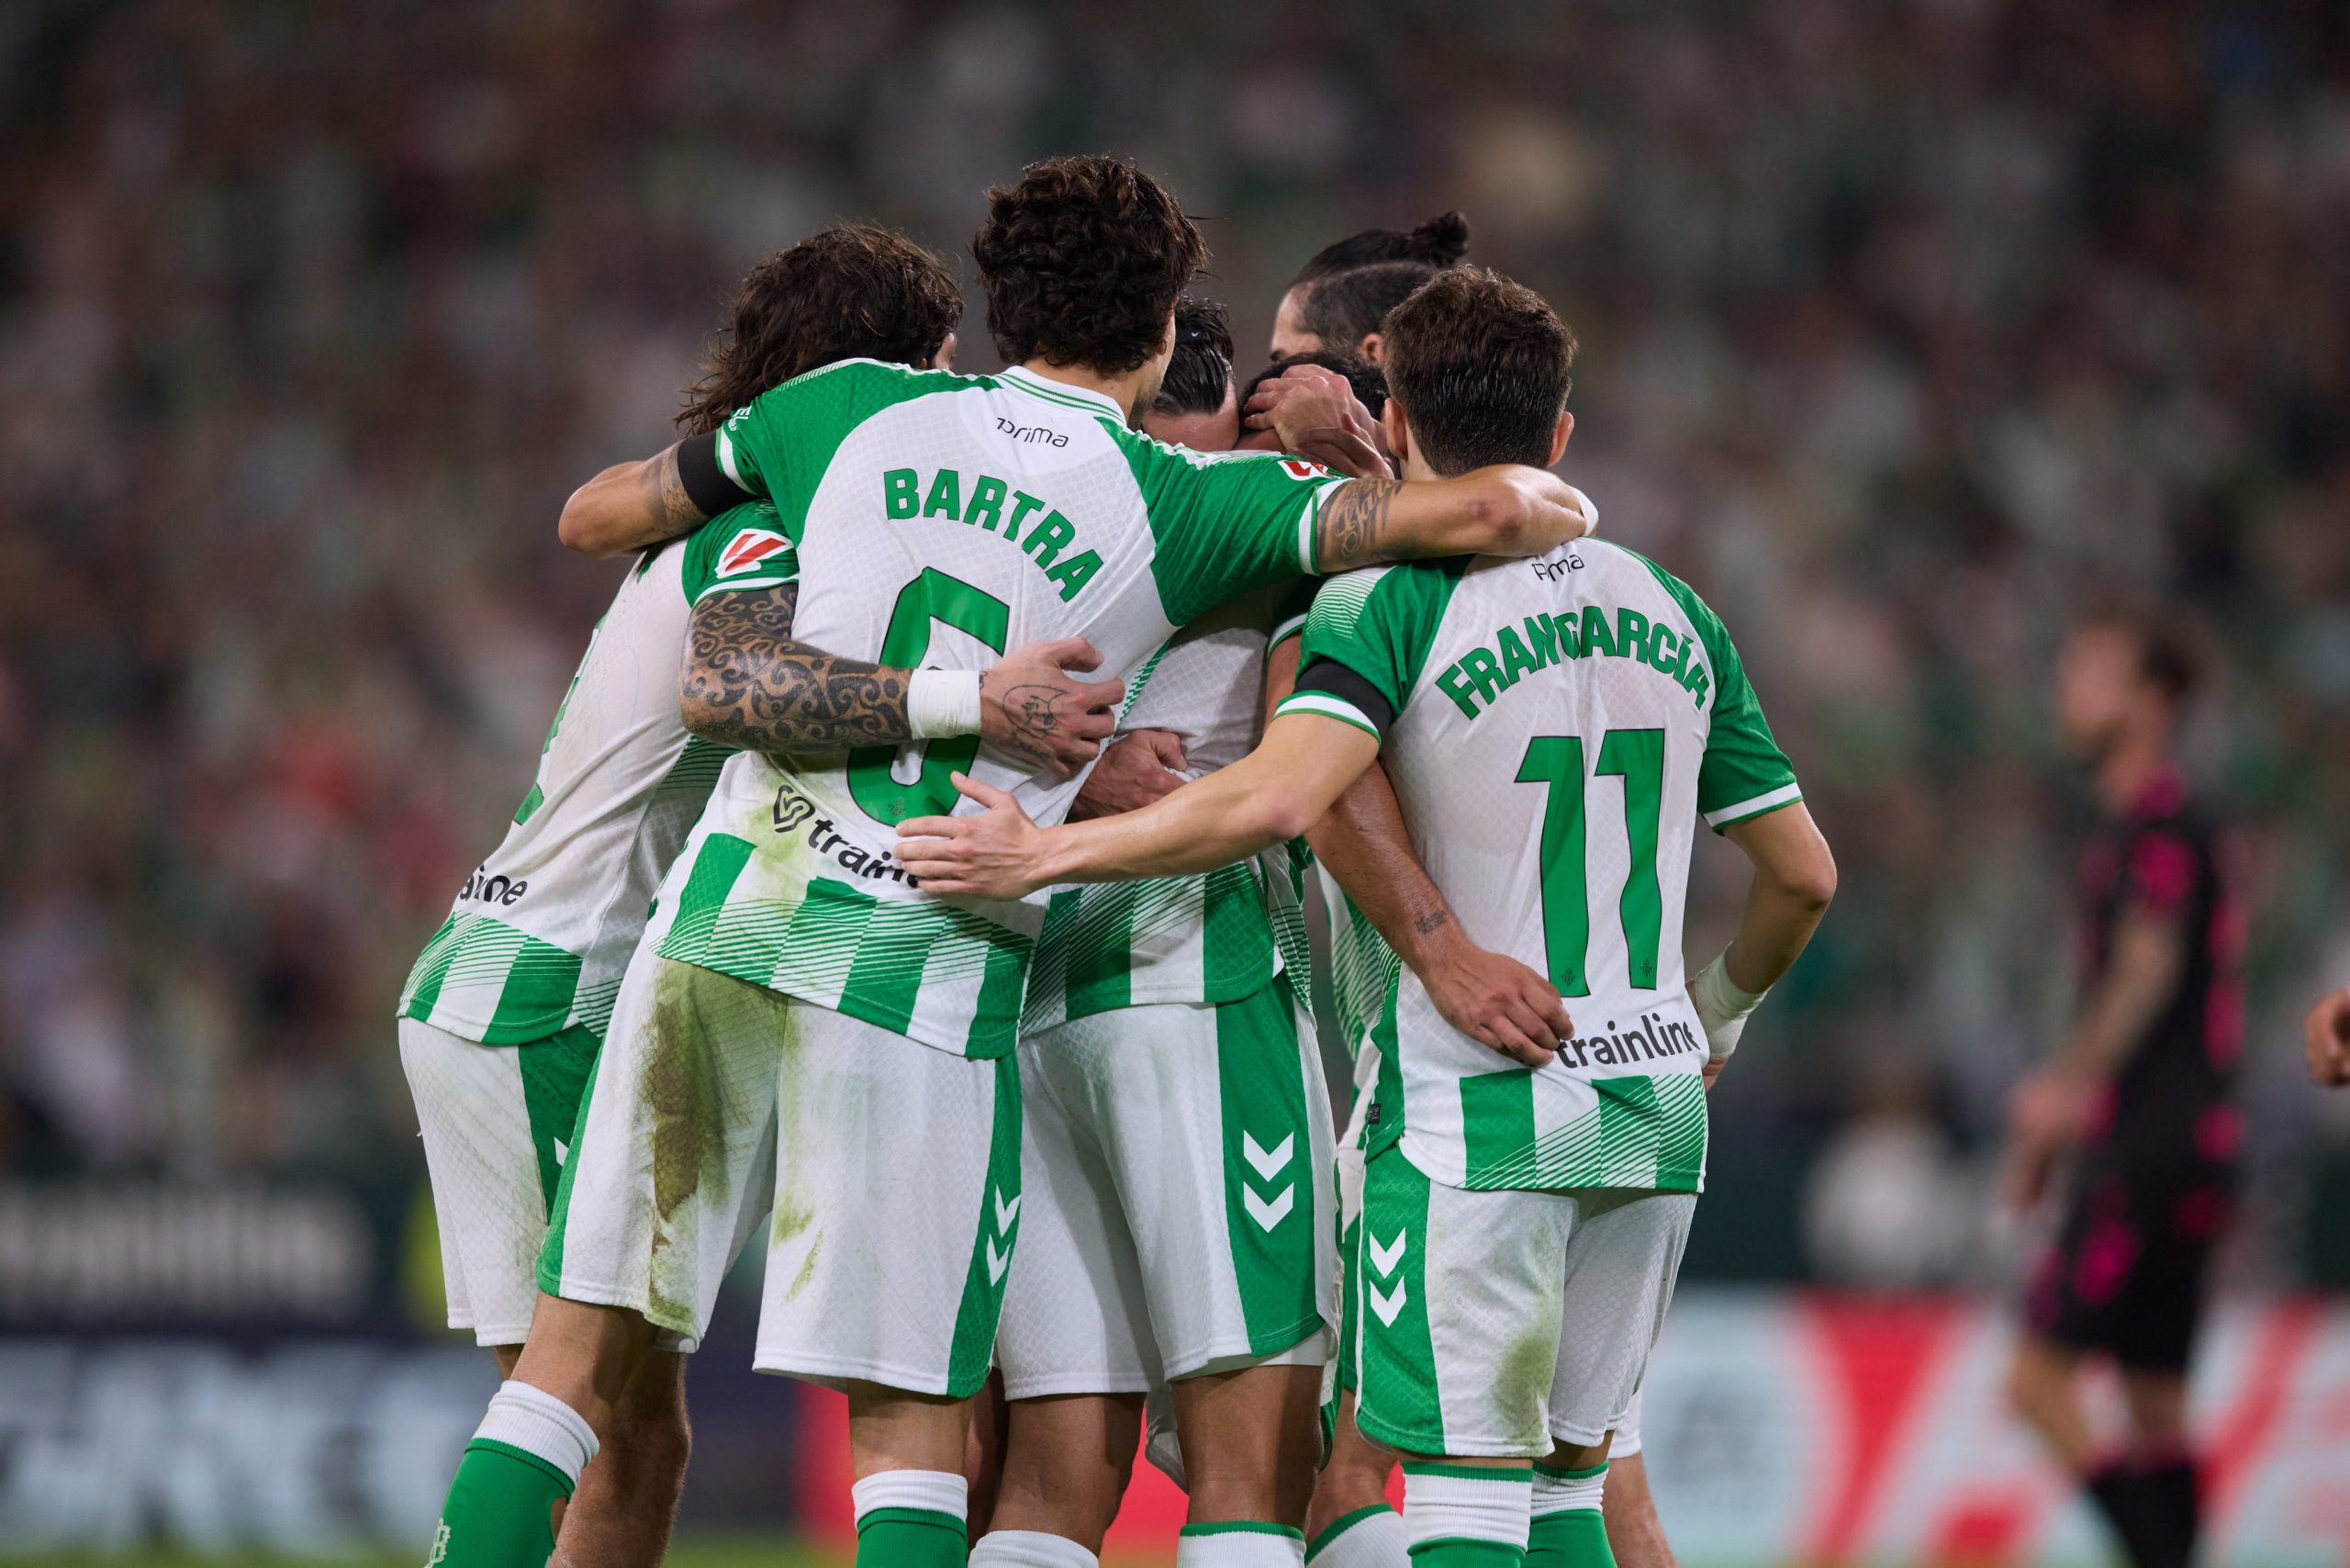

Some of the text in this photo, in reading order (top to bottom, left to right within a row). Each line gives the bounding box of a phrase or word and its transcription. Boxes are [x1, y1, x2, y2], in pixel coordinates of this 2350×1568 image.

[997, 417, 1069, 448] prima
[883, 467, 1104, 603] BARTRA
[1514, 728, 1664, 997] 11
